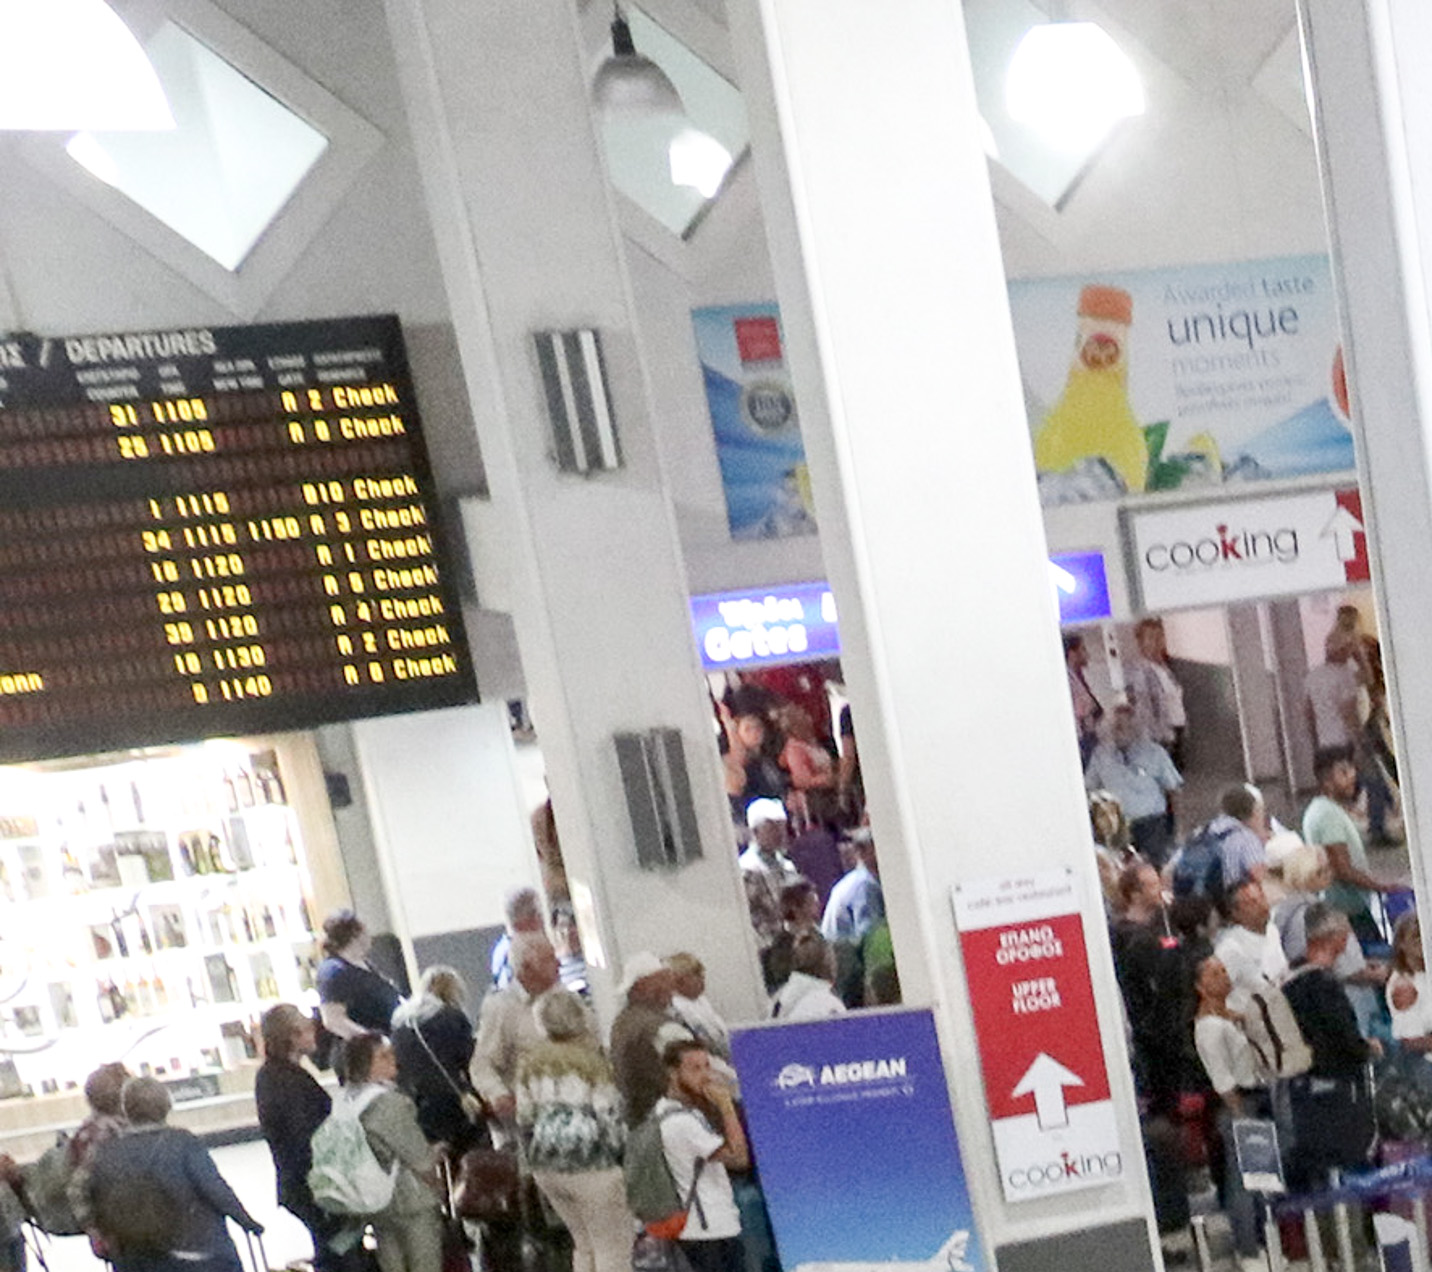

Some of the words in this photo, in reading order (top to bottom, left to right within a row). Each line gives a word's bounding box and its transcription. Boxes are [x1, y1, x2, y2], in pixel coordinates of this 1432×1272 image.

[1167, 303, 1299, 349] unique
[64, 327, 217, 365] DEPARTURES
[1146, 524, 1299, 571] cooking
[1011, 977, 1056, 1000] UPPER
[1012, 992, 1062, 1016] FLOOR
[820, 1057, 907, 1086] AEGEAN
[1009, 1151, 1122, 1189] cooking
